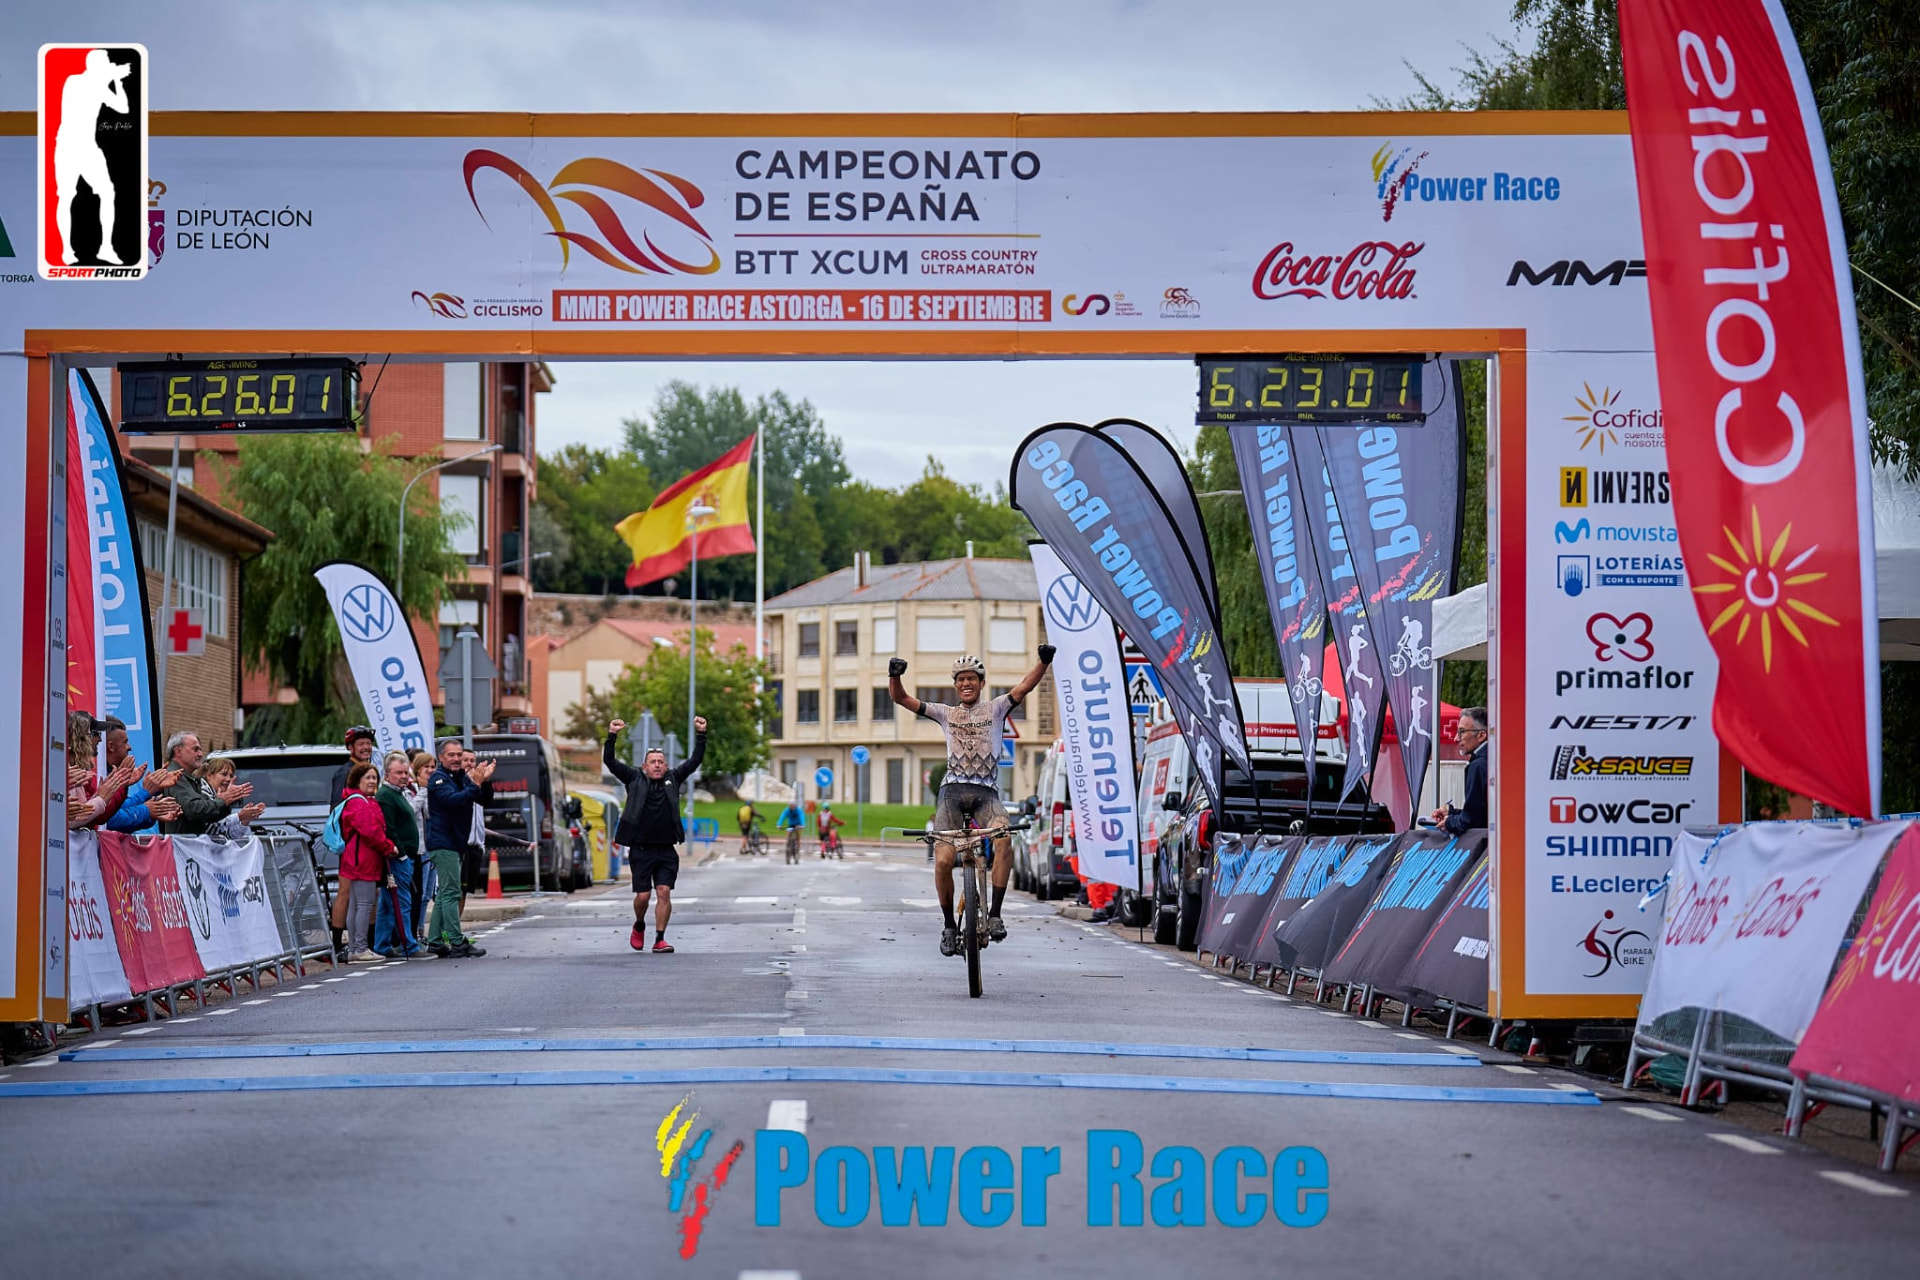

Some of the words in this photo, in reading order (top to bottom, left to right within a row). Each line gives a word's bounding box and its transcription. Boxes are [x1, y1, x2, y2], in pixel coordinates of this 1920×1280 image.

[736, 150, 1041, 180] CAMPEONATO
[1404, 174, 1487, 202] Power
[1493, 172, 1560, 202] Race
[735, 192, 790, 221] DE
[808, 184, 980, 221] ESPAÑA
[177, 205, 312, 227] DIPUTACIÓN
[177, 232, 203, 249] DE
[211, 228, 270, 249] LEÓN
[735, 250, 799, 275] BTT
[811, 250, 908, 275] XCUM
[920, 250, 967, 261] CROSS
[971, 250, 1038, 261] COUNTRY
[920, 262, 1035, 275] ULTRAMARATÓN
[1252, 241, 1426, 300] Coca-Cola
[473, 305, 543, 317] CICLISMO
[560, 295, 611, 320] MMR
[616, 295, 688, 320] POWER
[692, 295, 745, 320] RACE
[749, 295, 844, 320] ASTORGA
[860, 295, 884, 320] 16
[889, 295, 915, 320] DE
[918, 295, 1044, 320] SEPTIEMBRE
[1216, 412, 1236, 420] hour
[1592, 409, 1663, 429] Cofidi
[1624, 431, 1655, 439] cuenta
[1593, 471, 1670, 504] INVERS
[1597, 526, 1678, 542] movista
[1596, 554, 1684, 571] LOTERÍAS
[1556, 665, 1694, 697] primaflor
[1260, 726, 1296, 735] Primeros
[1549, 715, 1693, 730] NESTA
[1572, 756, 1692, 775] X-SAUCE
[1549, 797, 1691, 824] TowCar
[1546, 835, 1672, 857] SHIMAN
[1623, 957, 1645, 965] BIKE
